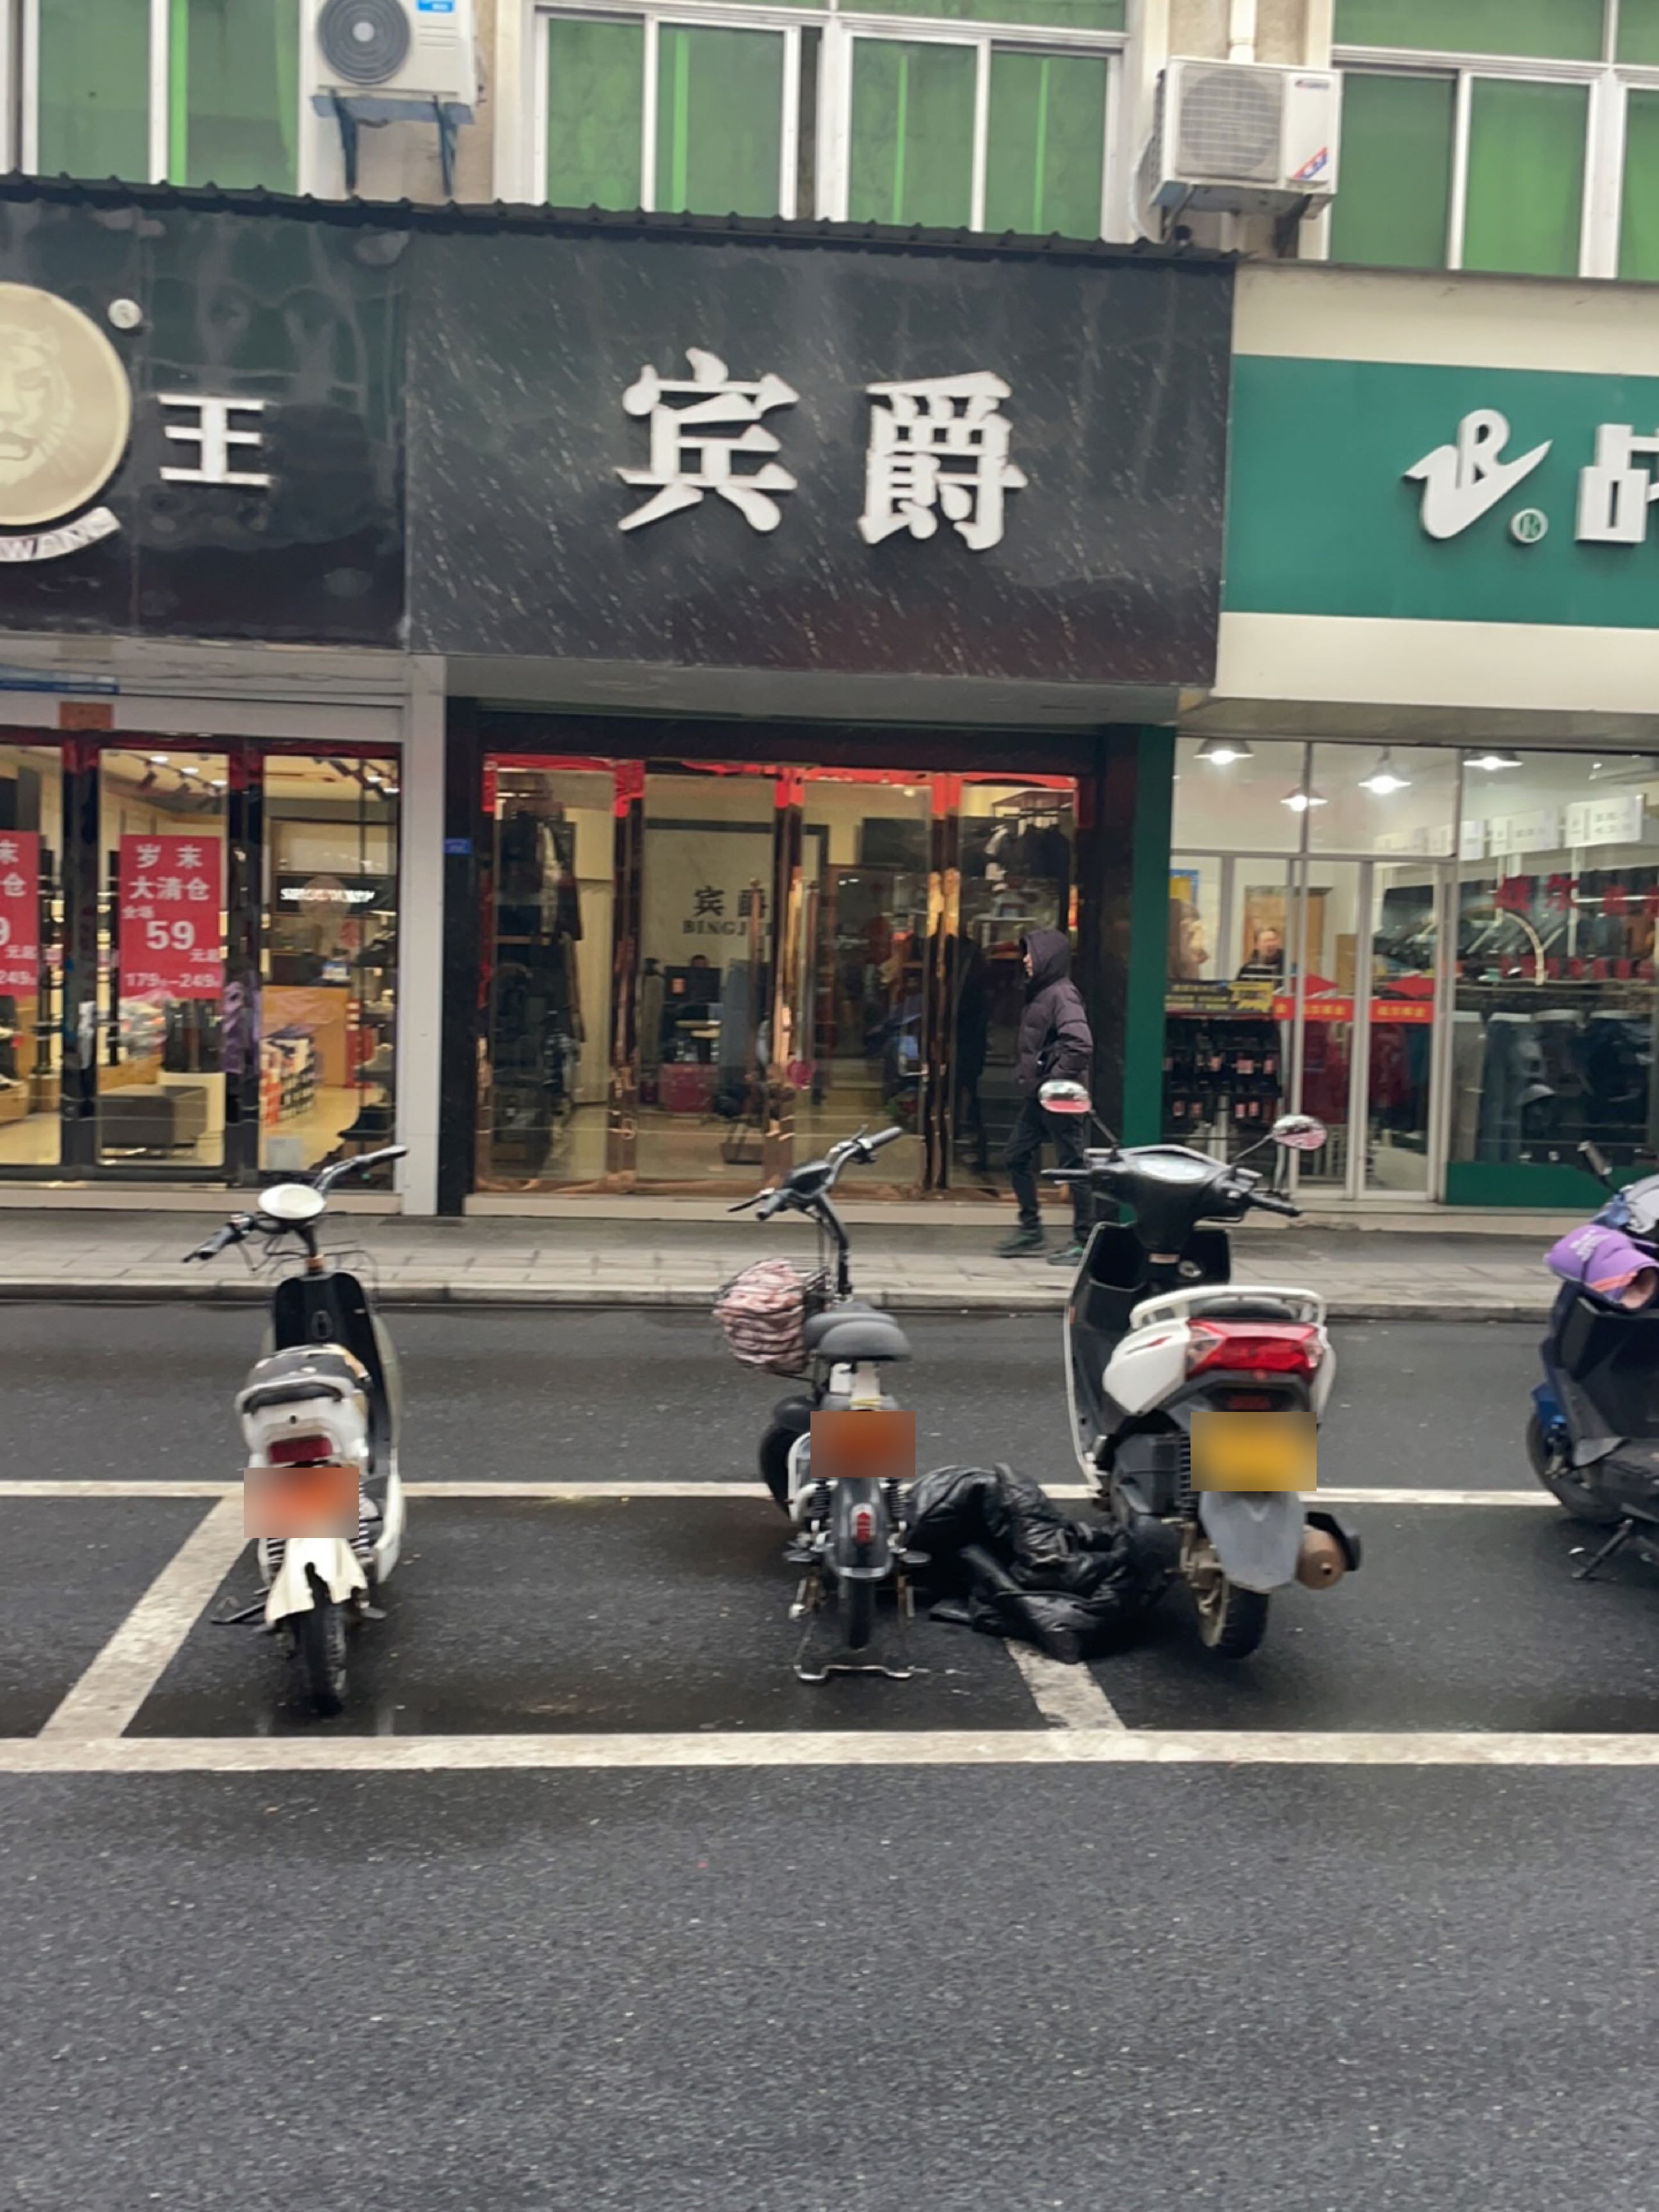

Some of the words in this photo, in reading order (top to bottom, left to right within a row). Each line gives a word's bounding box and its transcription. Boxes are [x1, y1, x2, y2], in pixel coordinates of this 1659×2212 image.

[157, 393, 271, 485] 王
[614, 347, 1028, 550] 宾爵
[135, 844, 204, 869] 岁末
[129, 876, 211, 901] 大清仓
[145, 920, 195, 950] 59
[682, 920, 773, 936] BINGJ
